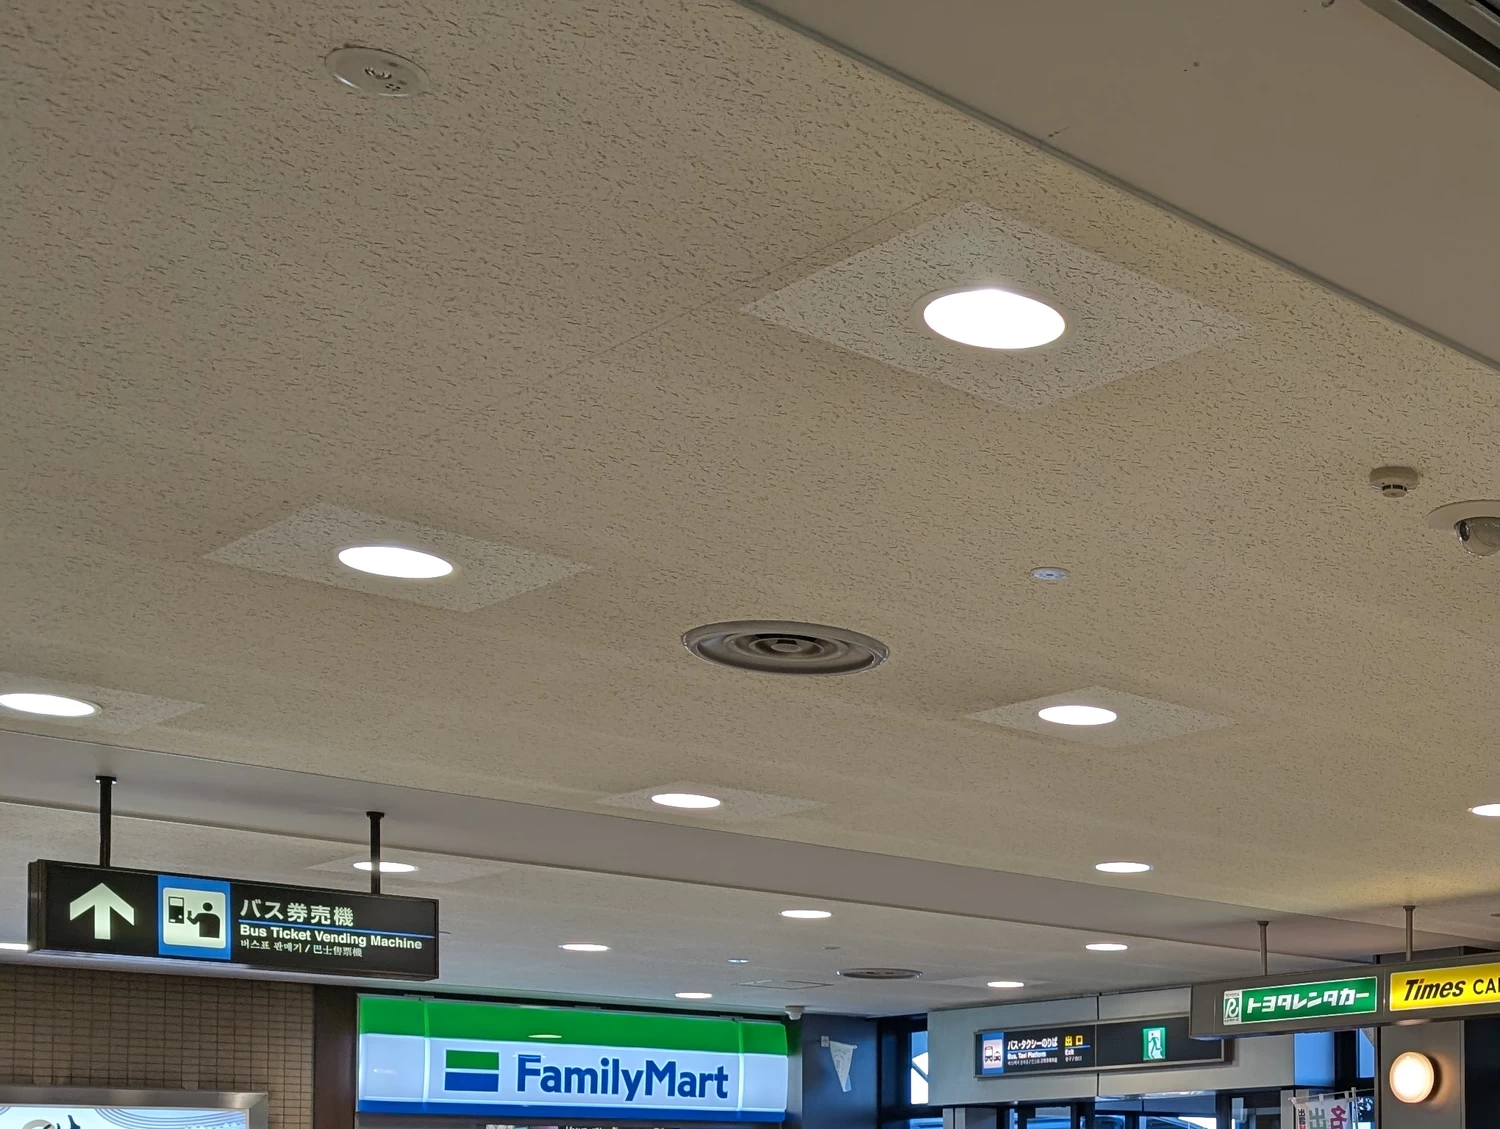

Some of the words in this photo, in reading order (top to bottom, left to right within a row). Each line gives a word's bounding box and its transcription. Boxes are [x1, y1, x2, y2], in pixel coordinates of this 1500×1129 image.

[240, 899, 354, 927] バス券売機
[240, 924, 267, 936] Bus
[270, 926, 312, 941] Ticket
[315, 931, 367, 947] Vending
[370, 936, 422, 950] Machine
[240, 939, 270, 950] 버스표
[1247, 988, 1370, 1014] トヨタレンタカー
[1404, 978, 1466, 1002] Times
[1007, 1036, 1058, 1050] バス・タクシーのりば
[1064, 1035, 1083, 1046] 出口
[516, 1054, 729, 1100] FamilyMart
